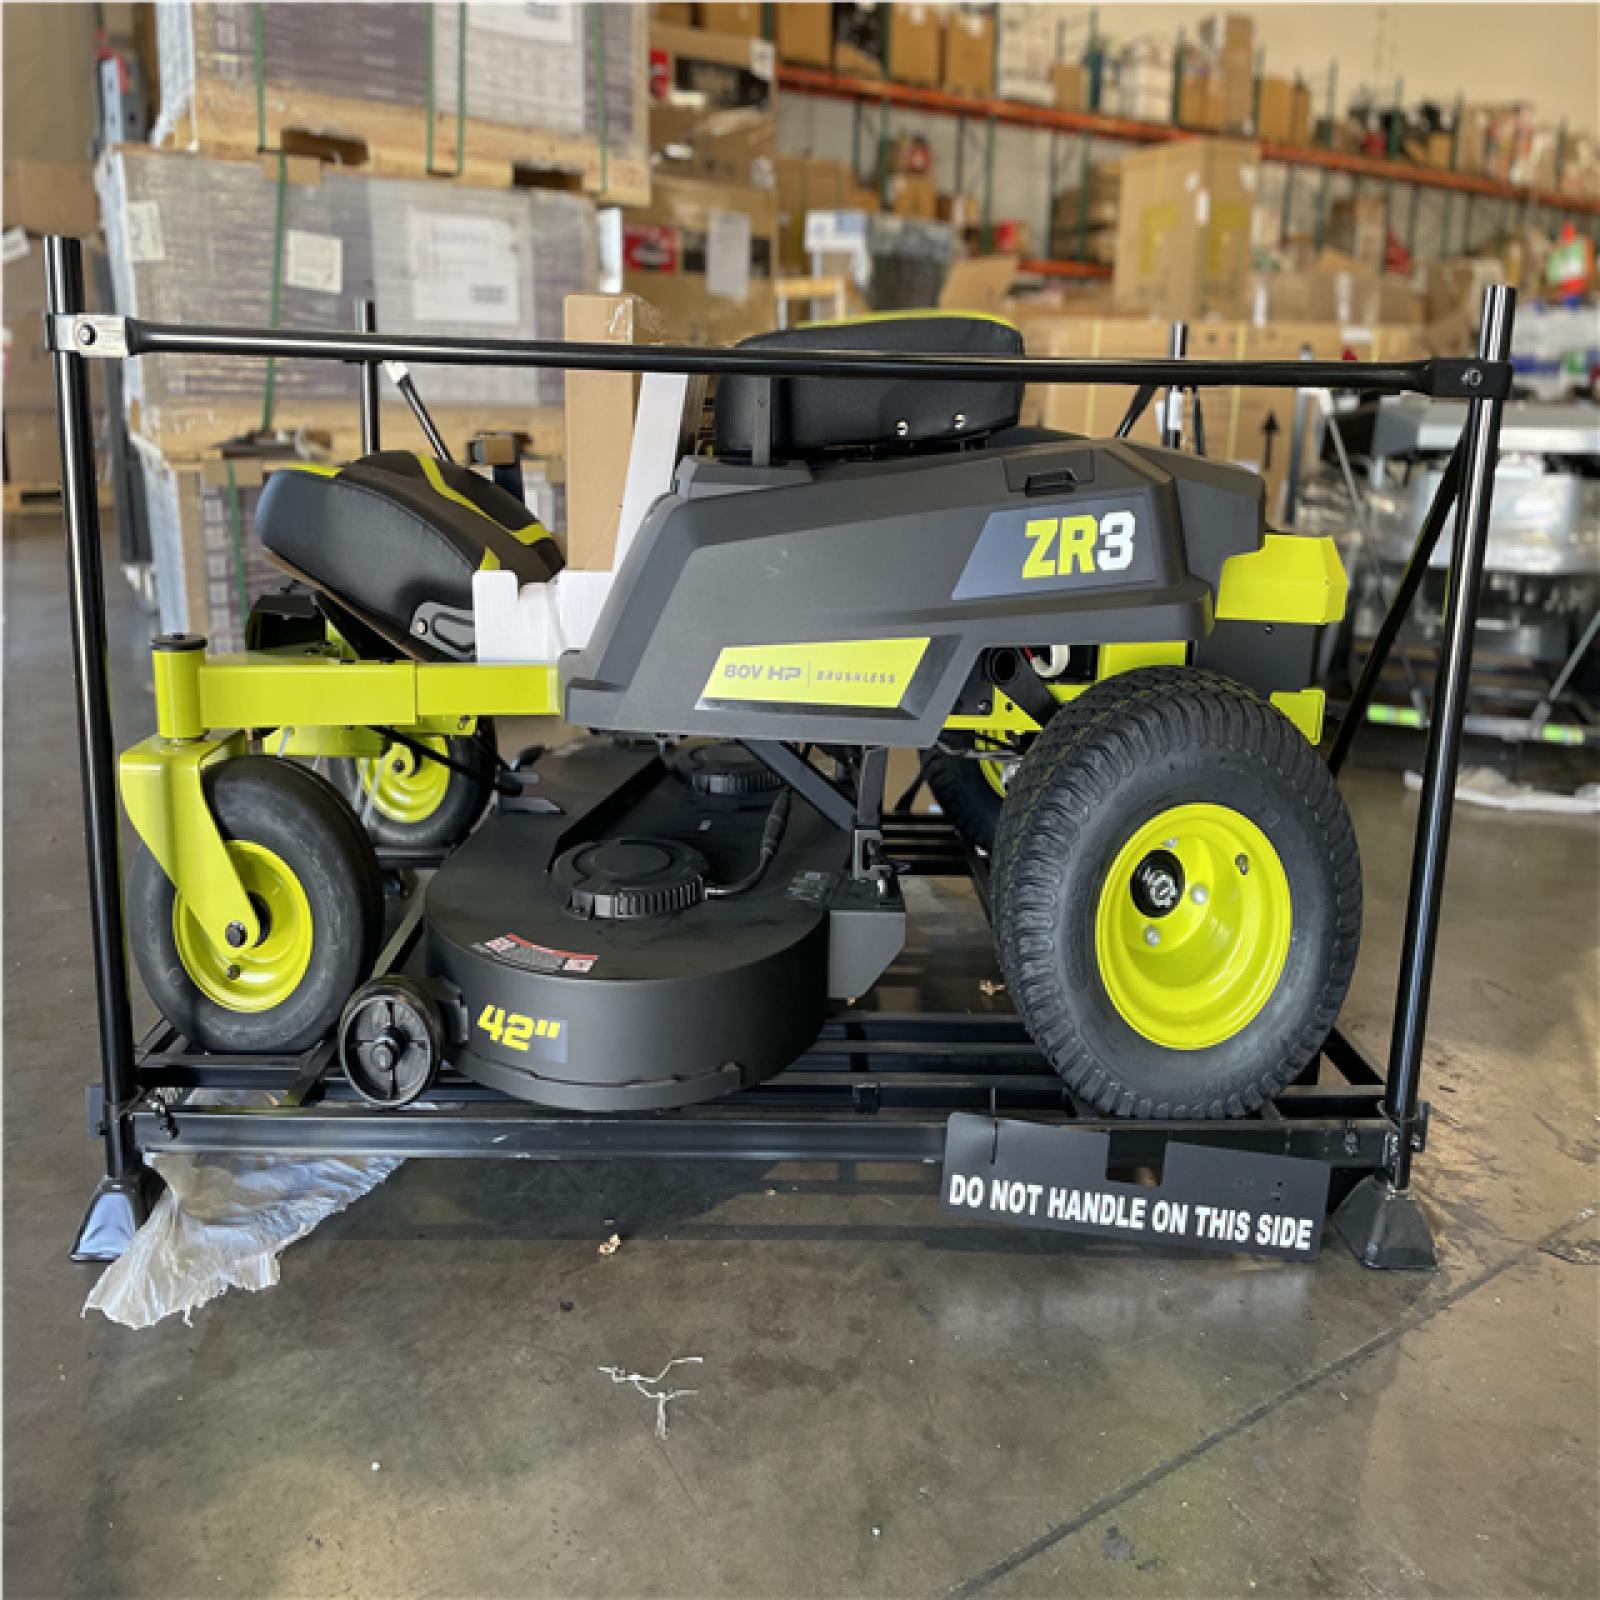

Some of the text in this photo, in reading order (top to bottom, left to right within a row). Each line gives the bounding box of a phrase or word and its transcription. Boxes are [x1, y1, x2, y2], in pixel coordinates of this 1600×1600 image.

[1022, 510, 1136, 579] ZR3
[724, 664, 764, 679] 80V
[767, 665, 801, 681] HP
[477, 1003, 561, 1052] 42"
[949, 1173, 1313, 1250] DO NOT HANDLE ON THIS SIDE
